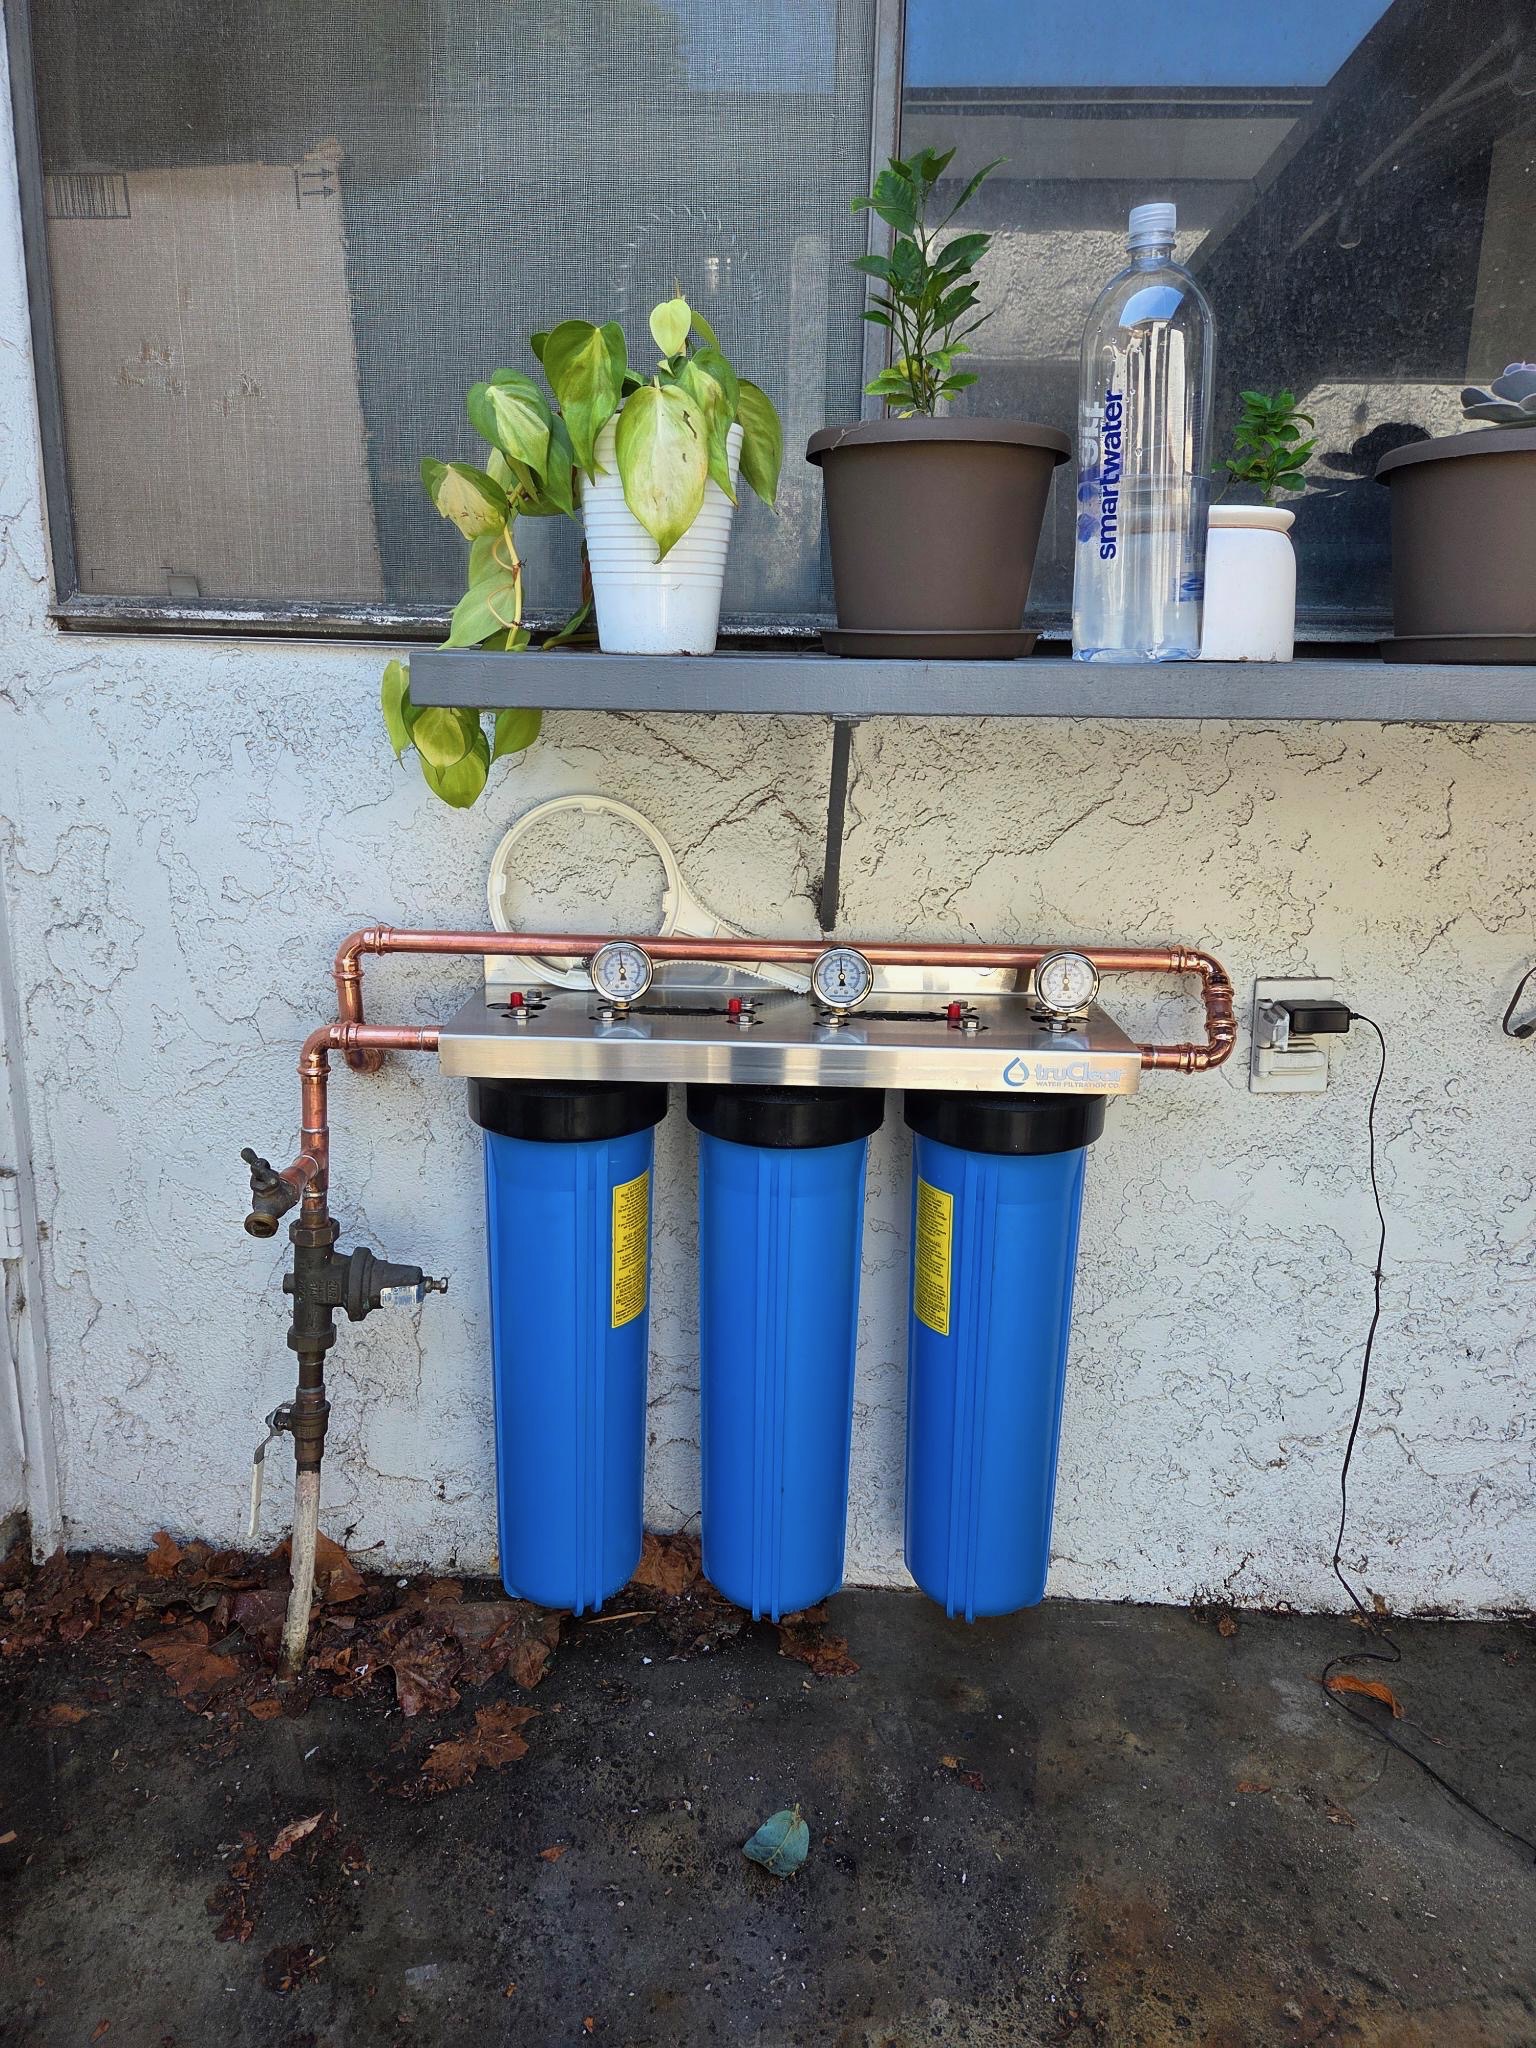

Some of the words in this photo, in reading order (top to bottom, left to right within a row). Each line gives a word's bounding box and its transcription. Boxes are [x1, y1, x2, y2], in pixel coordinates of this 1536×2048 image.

[1099, 389, 1123, 560] smartwater
[1034, 1061, 1121, 1081] truClear
[1063, 1081, 1106, 1089] FILTRATION
